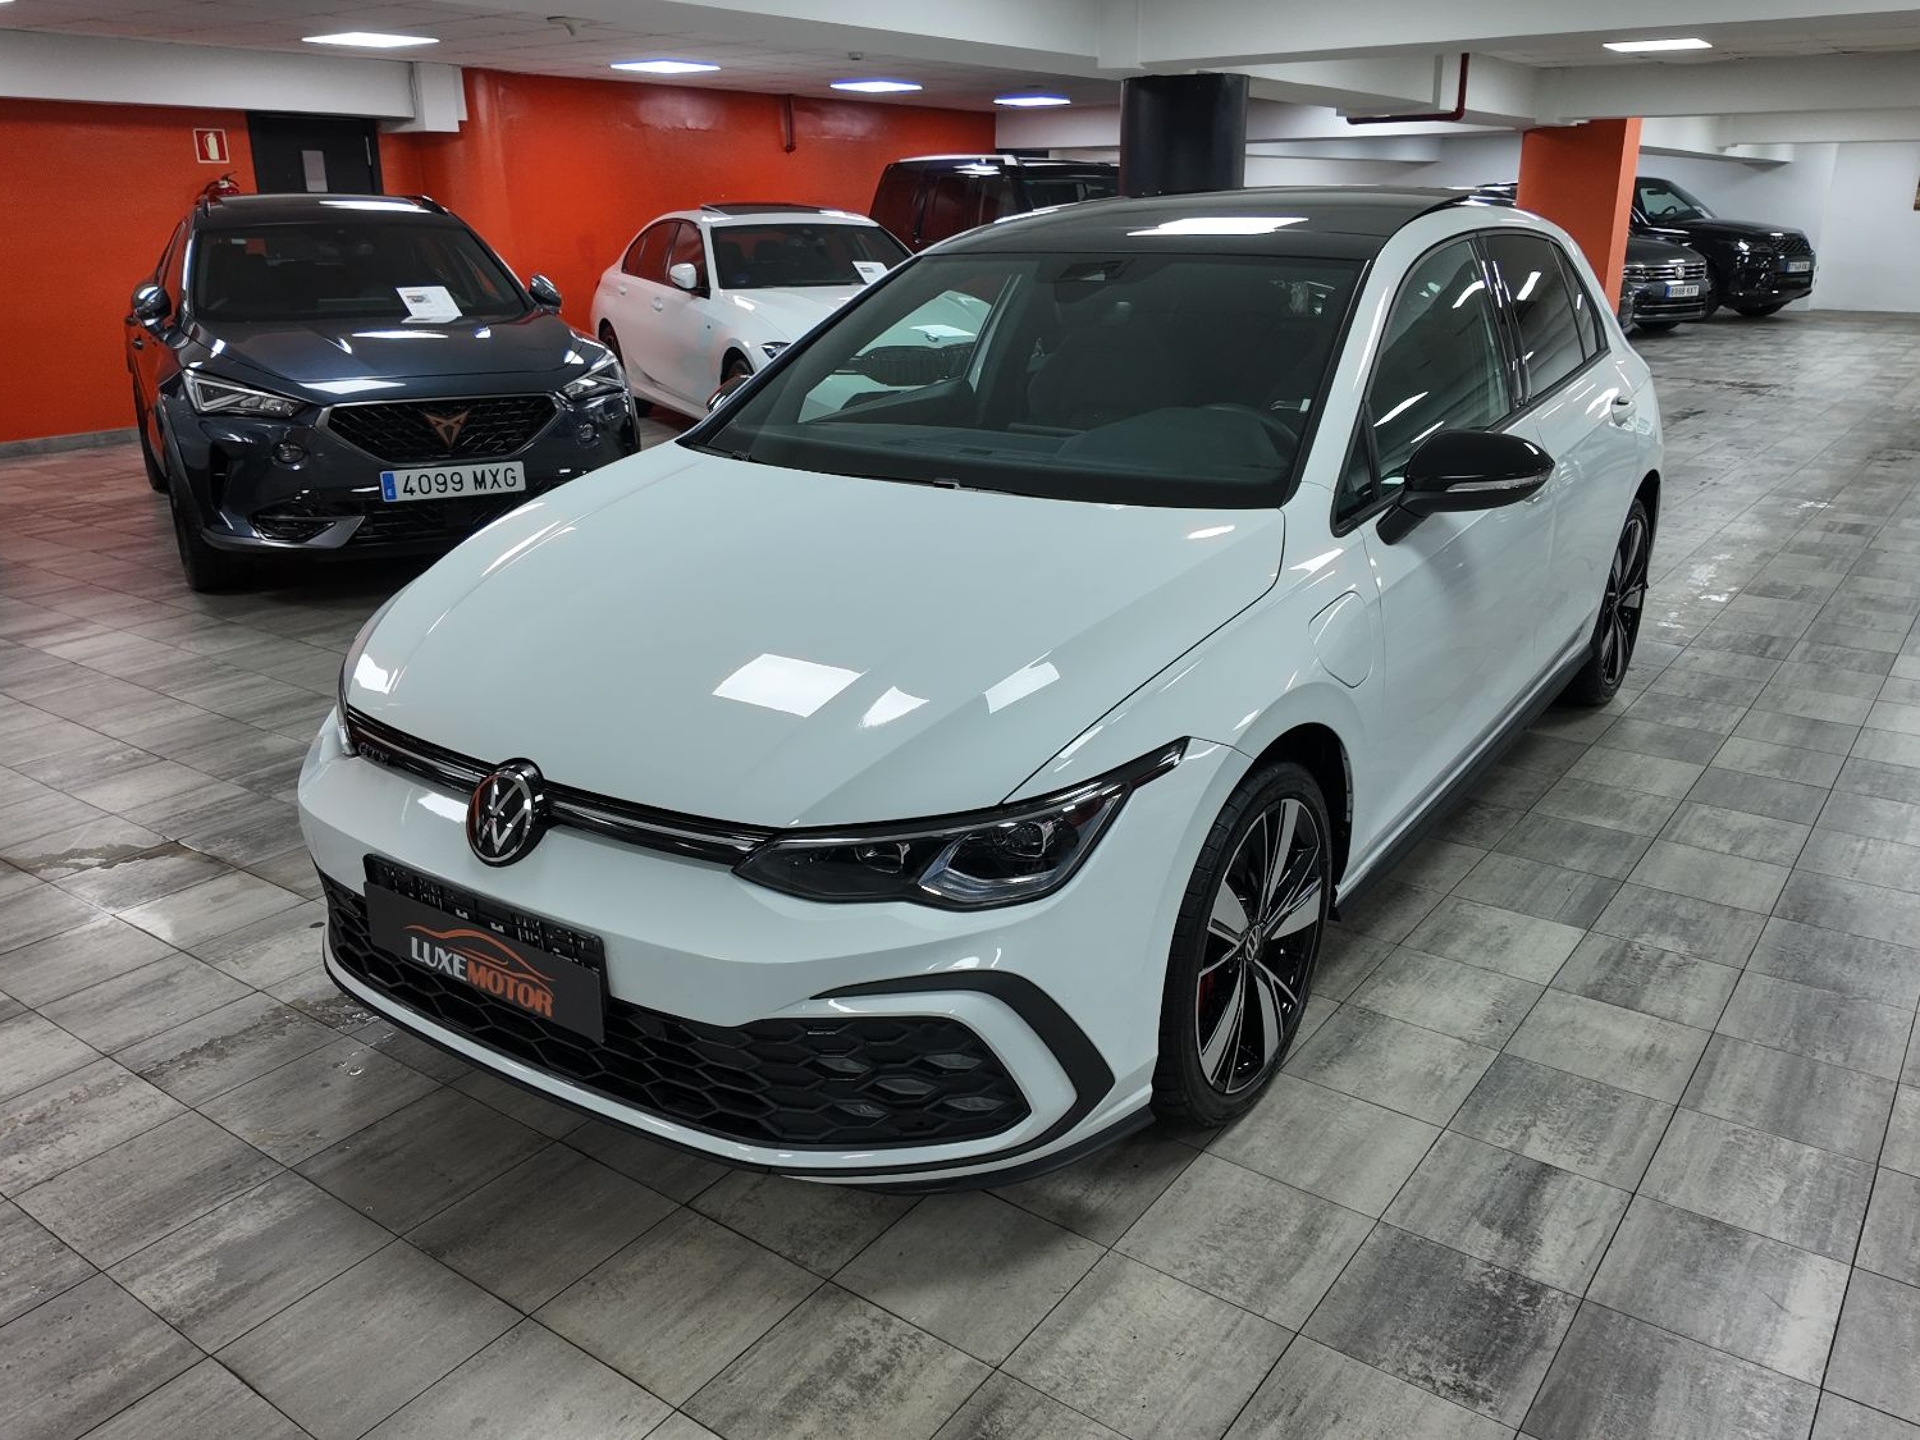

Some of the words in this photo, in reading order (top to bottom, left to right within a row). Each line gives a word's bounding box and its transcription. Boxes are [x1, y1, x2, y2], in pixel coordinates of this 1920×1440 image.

[402, 471, 465, 496] 4099
[473, 467, 517, 490] MXG
[411, 936, 554, 1017] LUXEMOTOR
